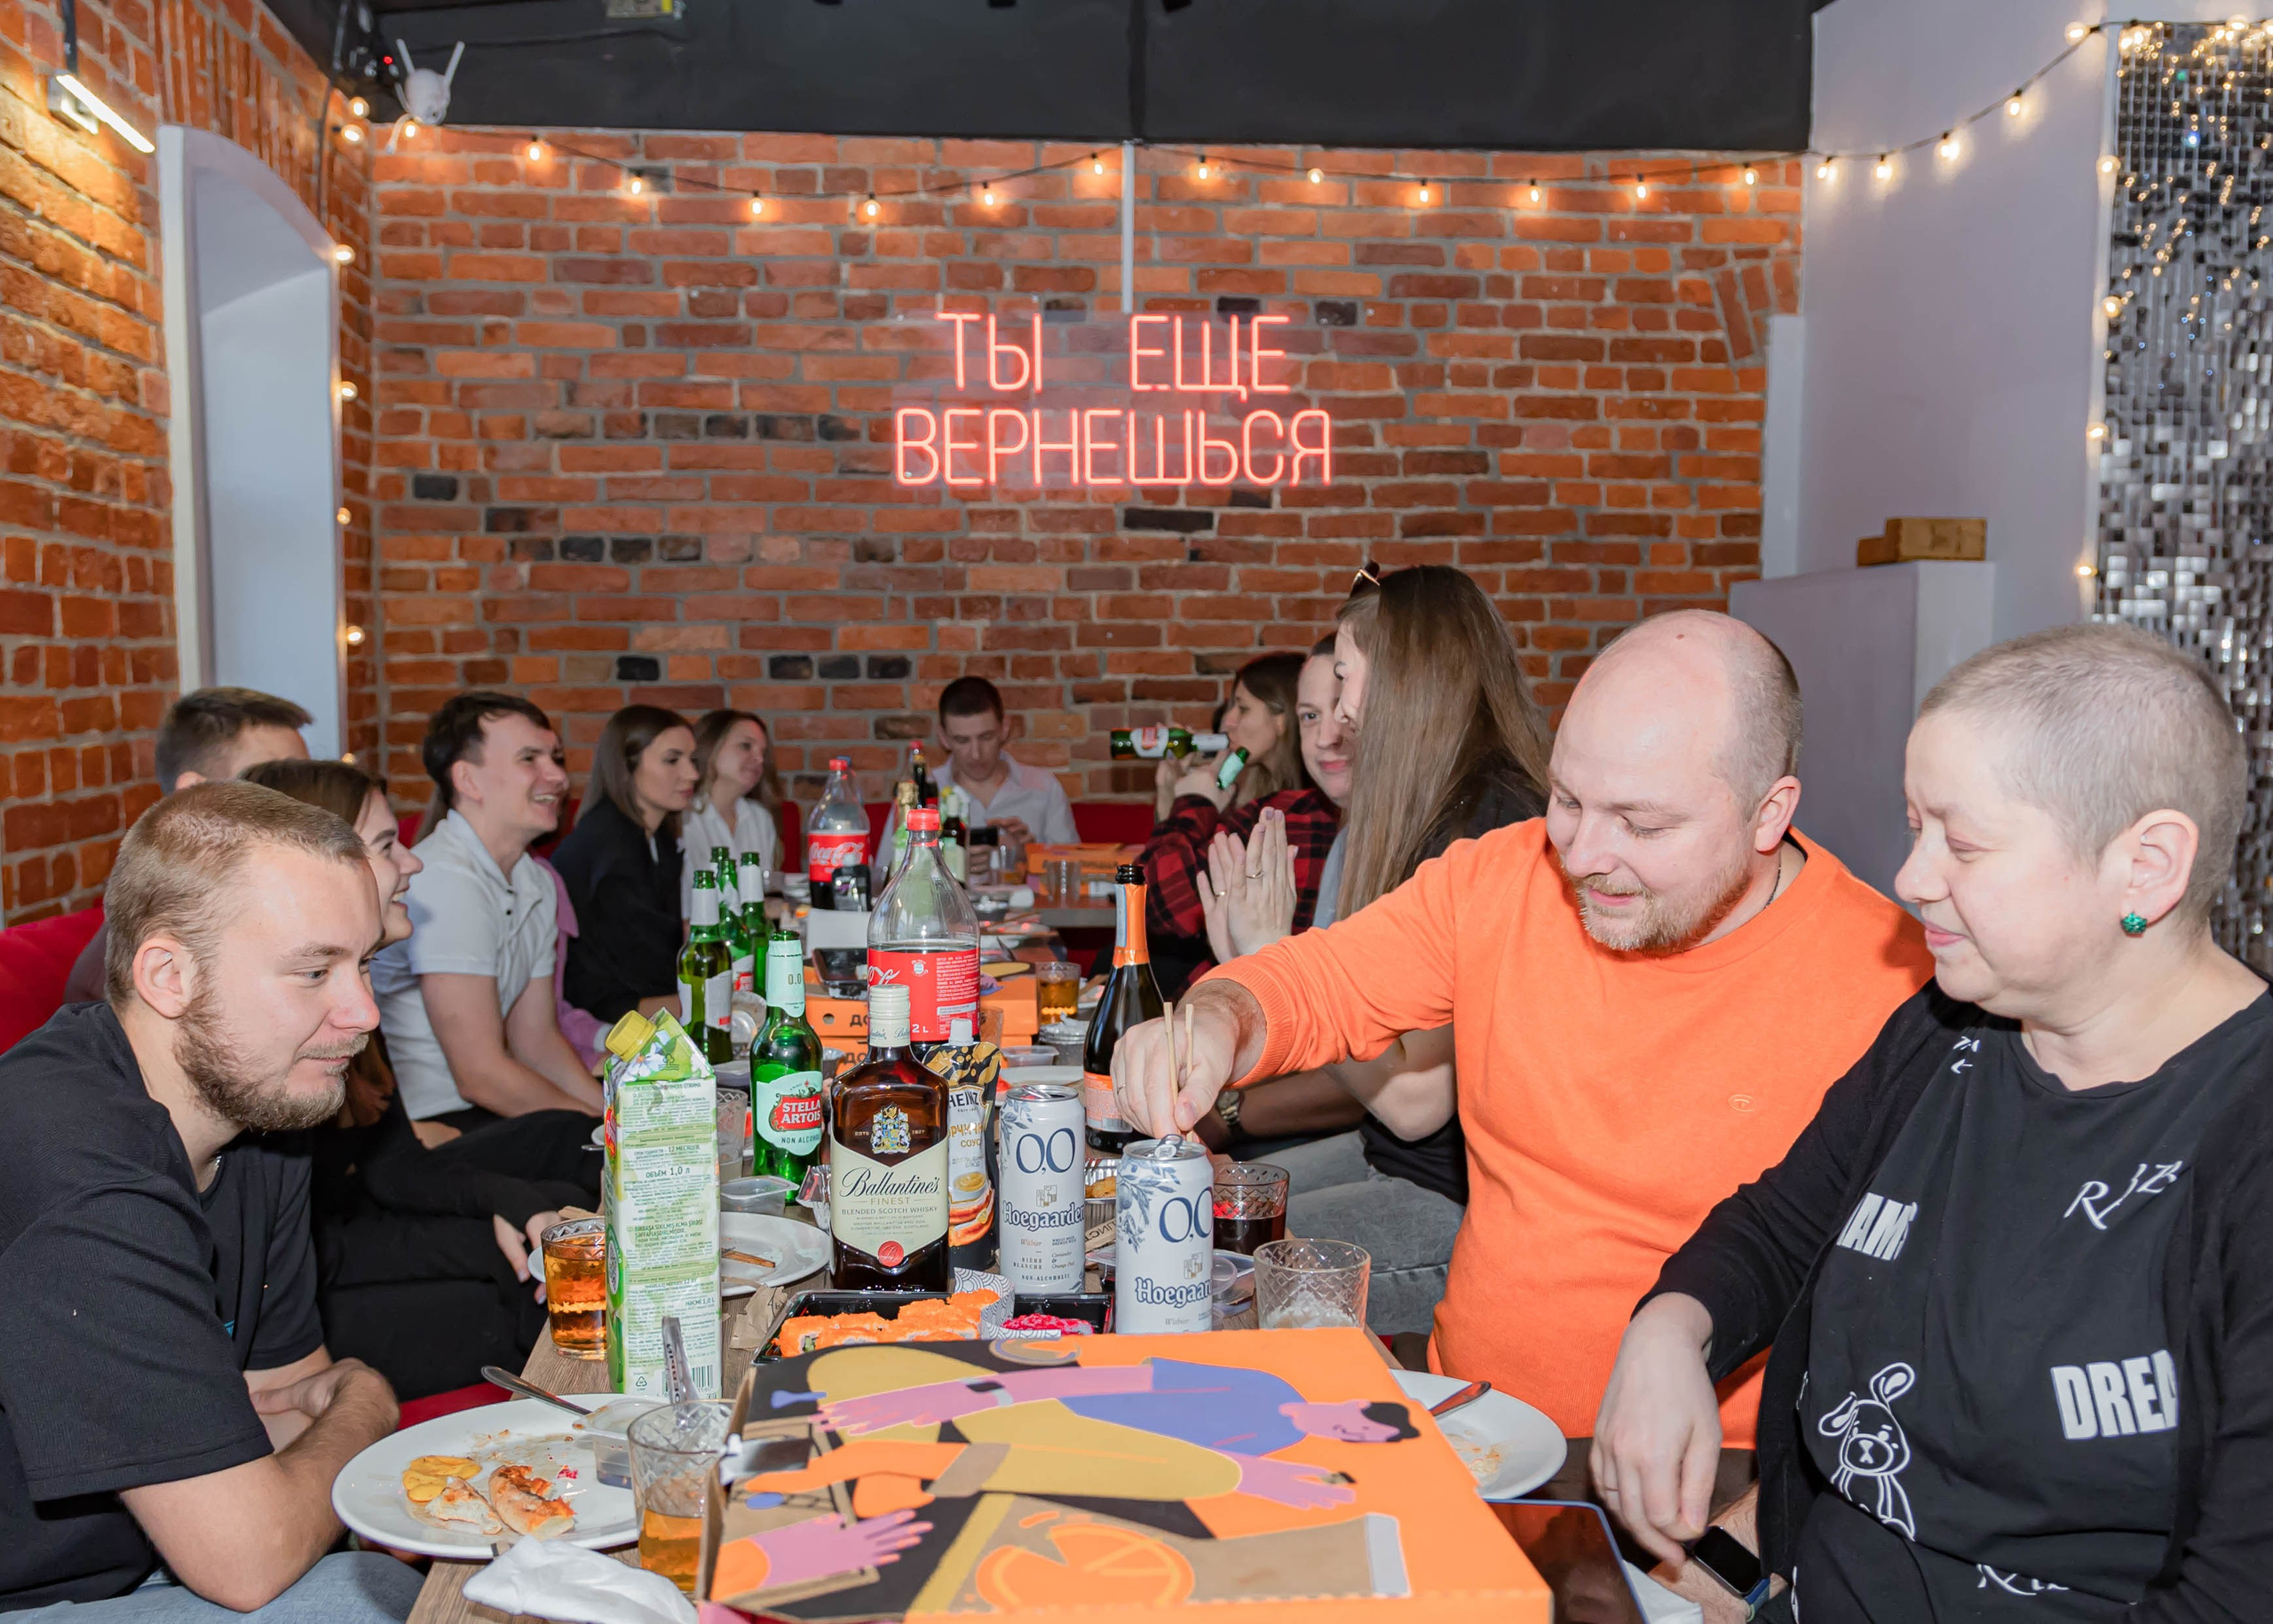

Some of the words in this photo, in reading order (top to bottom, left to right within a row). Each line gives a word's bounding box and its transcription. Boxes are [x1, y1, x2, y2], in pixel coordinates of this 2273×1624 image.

[935, 313, 1042, 393] ТЫ
[1129, 313, 1291, 402] ЕЩЕ
[895, 408, 1331, 487] ВЕРНЕШЬСЯ
[912, 1024, 921, 1034] 2
[782, 1099, 820, 1113] STELLA
[781, 1110, 821, 1124] ARTOIS
[1016, 1127, 1076, 1175] 0,0
[669, 1166, 683, 1176] 1,0
[839, 1166, 940, 1197] Ballantine's
[870, 1197, 911, 1206] FINEST
